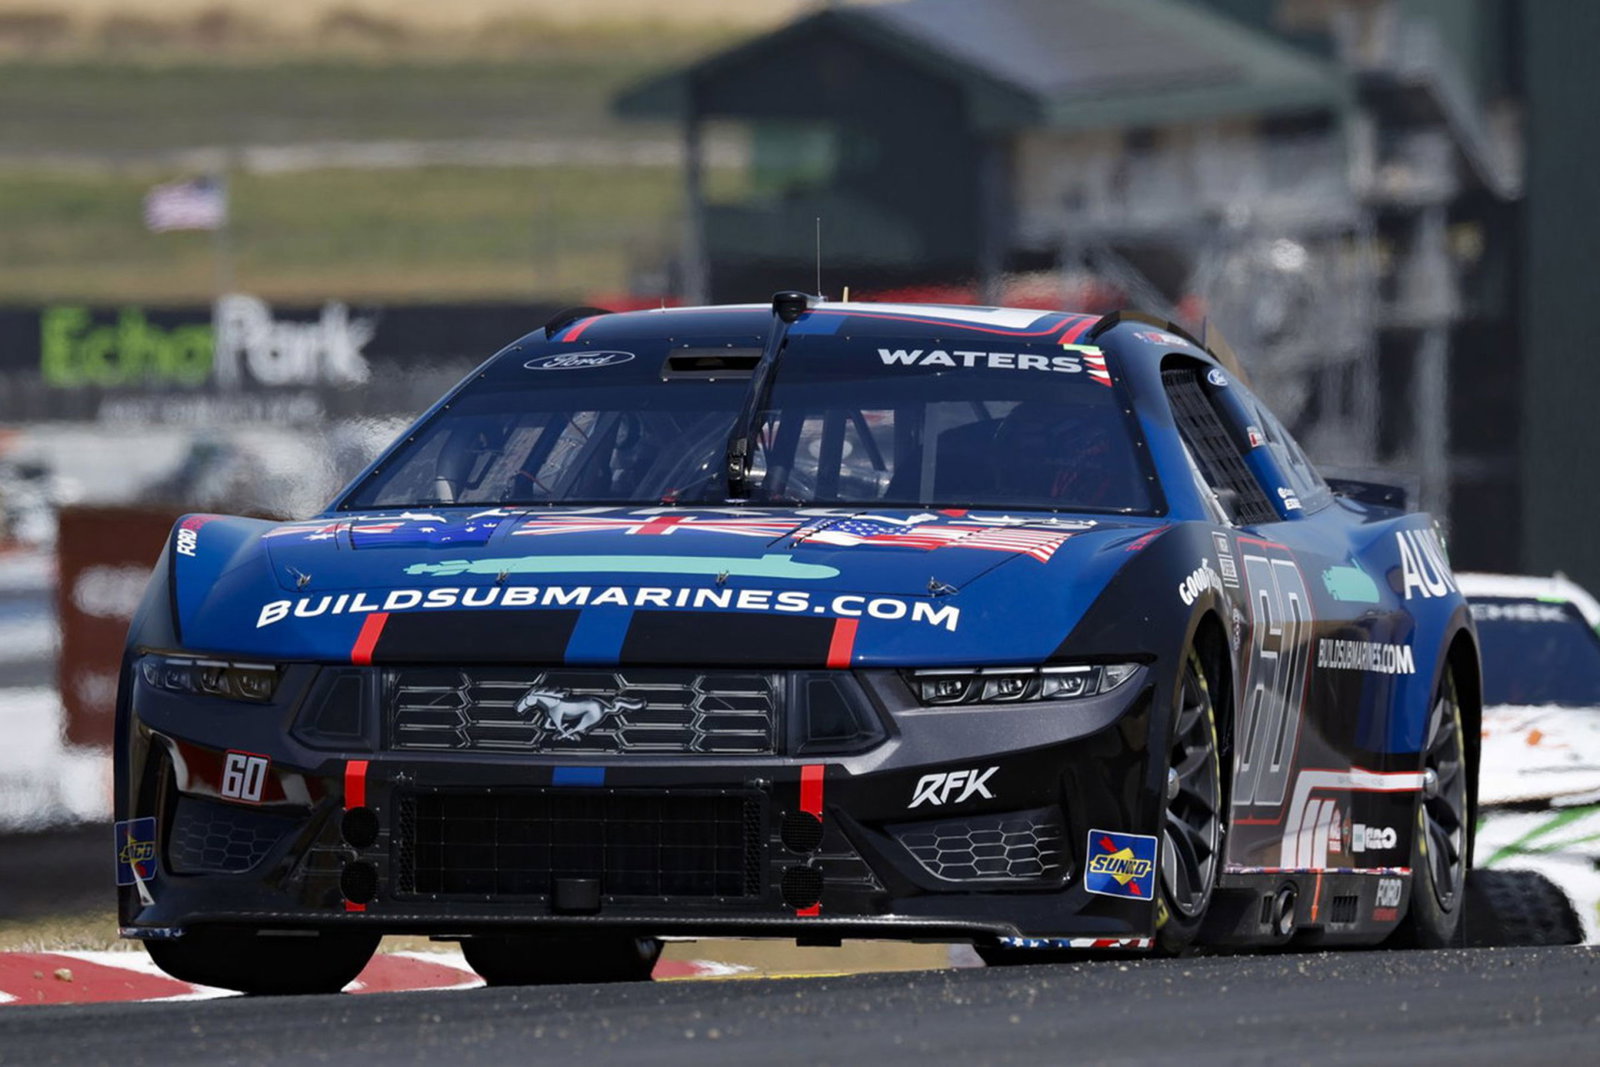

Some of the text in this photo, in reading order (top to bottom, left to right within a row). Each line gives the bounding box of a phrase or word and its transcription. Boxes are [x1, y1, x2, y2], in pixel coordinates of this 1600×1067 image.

[40, 294, 378, 388] EchoPark
[542, 352, 616, 369] Ford
[877, 348, 1083, 373] WATERS
[177, 528, 198, 557] FORD
[255, 587, 961, 632] BUILDSUBMARINES.COM
[221, 752, 268, 801] 60
[907, 765, 1001, 809] RFK
